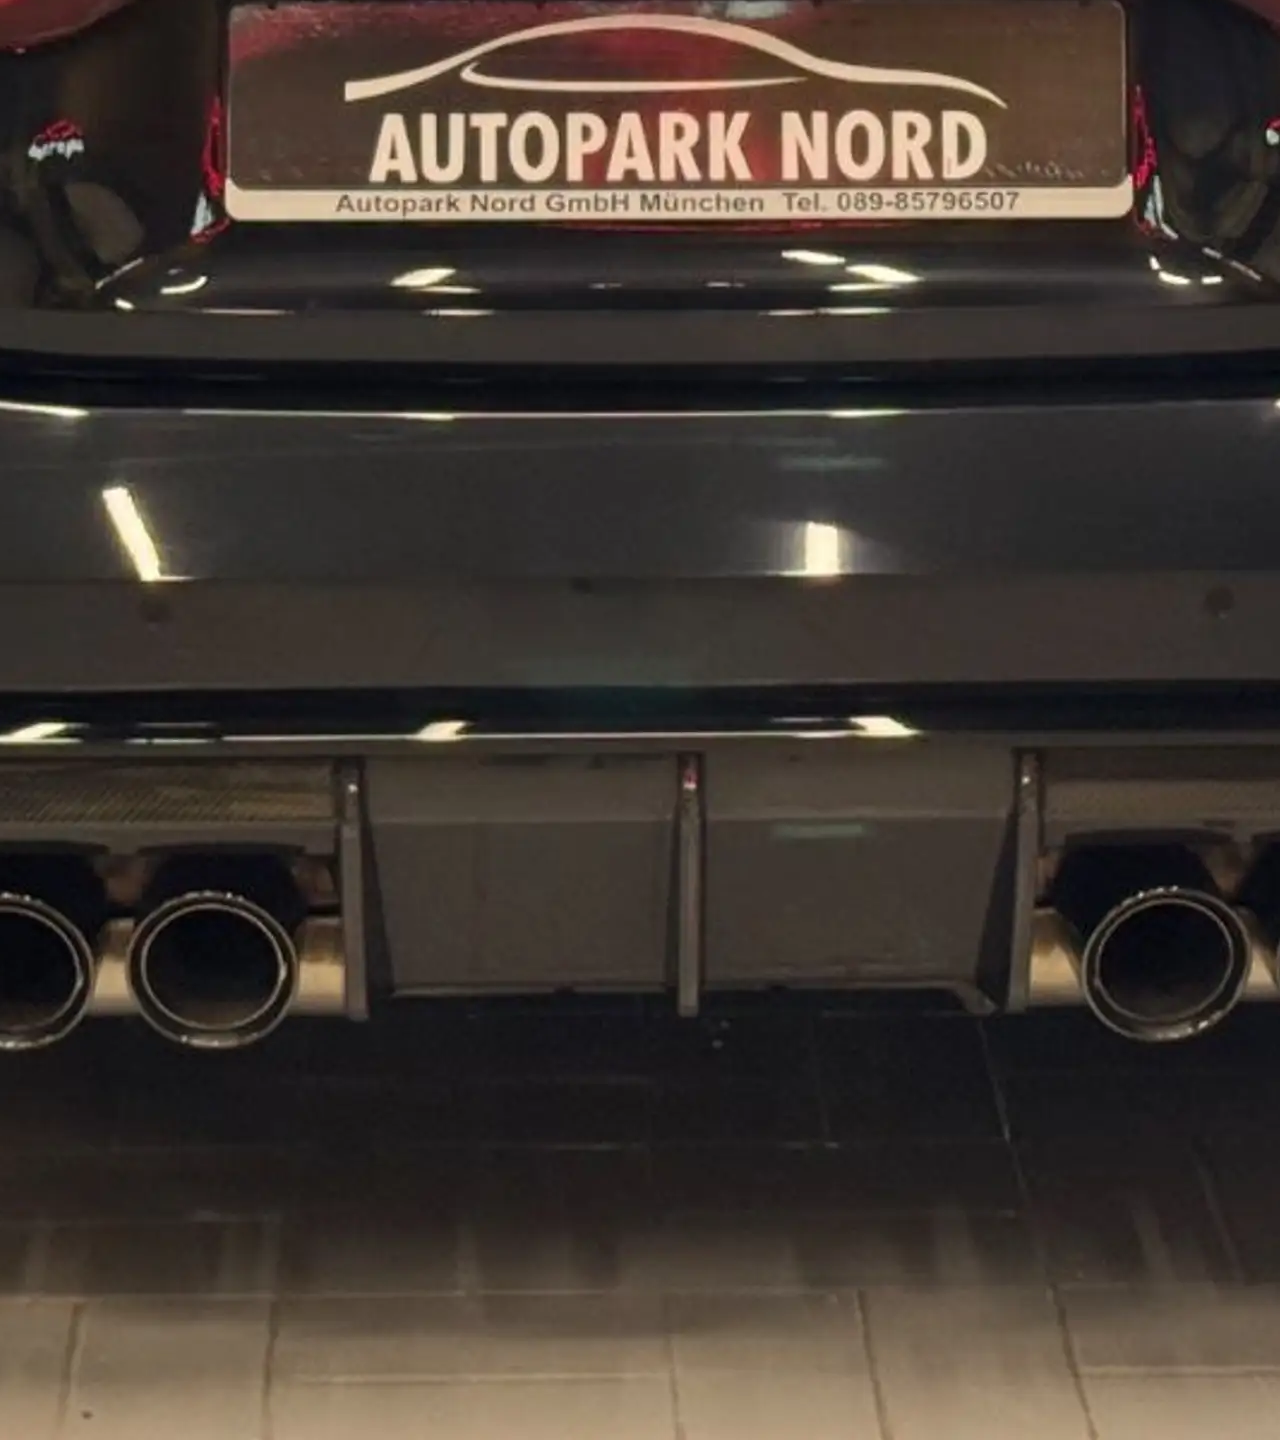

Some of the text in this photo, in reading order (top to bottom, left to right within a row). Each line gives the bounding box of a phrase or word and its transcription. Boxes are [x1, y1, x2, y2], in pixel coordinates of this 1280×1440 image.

[369, 109, 987, 183] AUTOPARK NORD
[335, 191, 1019, 216] Autopark Nord GmbH München Tel. 089-85796507
